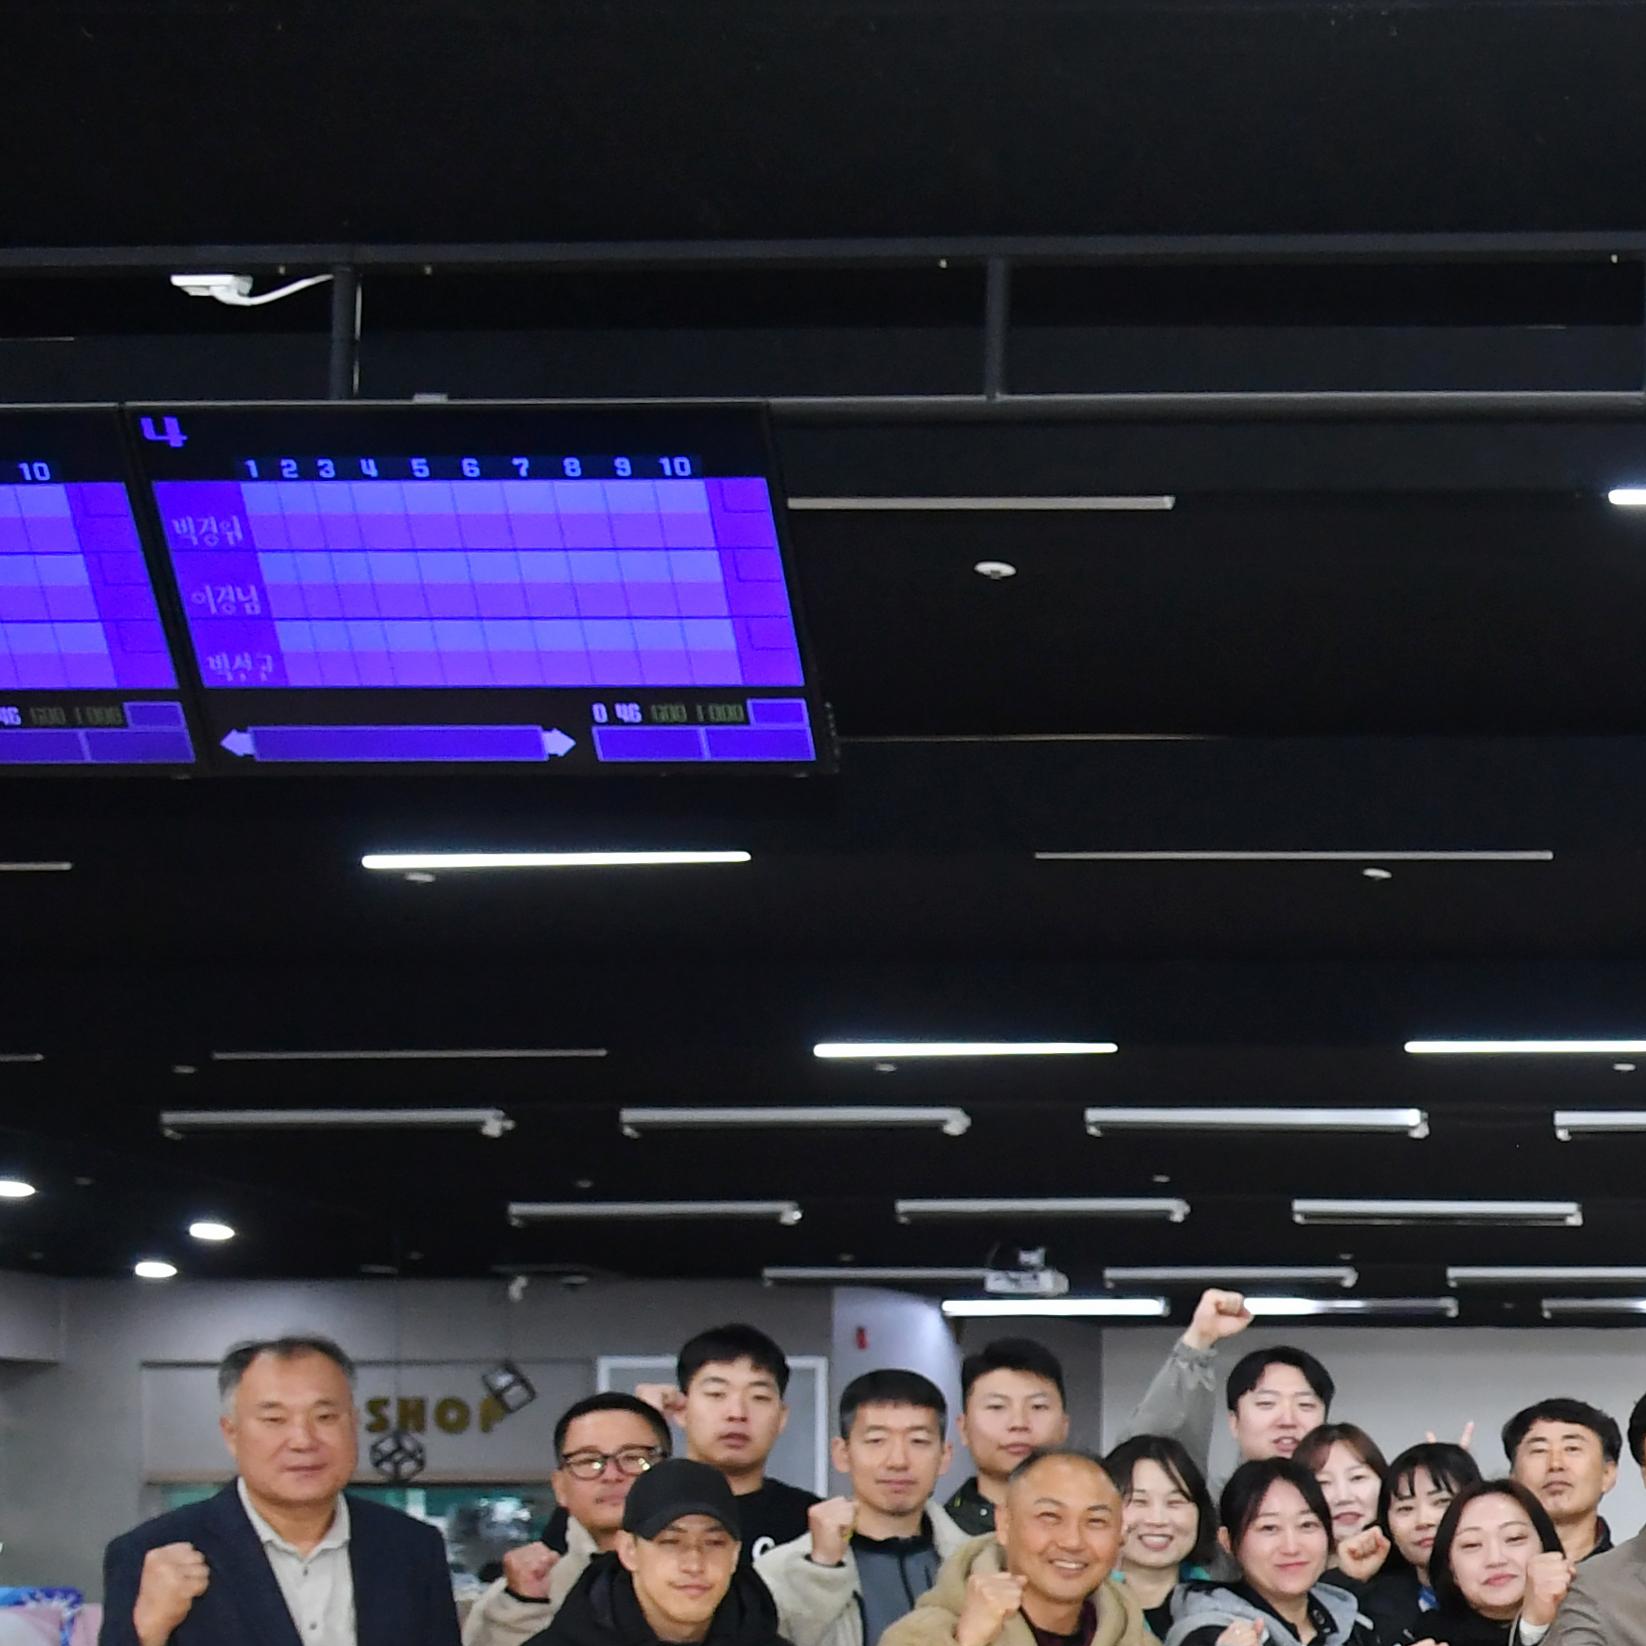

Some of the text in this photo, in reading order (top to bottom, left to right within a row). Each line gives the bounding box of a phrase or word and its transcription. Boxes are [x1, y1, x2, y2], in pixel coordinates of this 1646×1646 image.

[141, 416, 187, 447] 4
[20, 463, 50, 480] 10
[248, 458, 690, 478] 1 2 3 4 5 6 7 8 9 10
